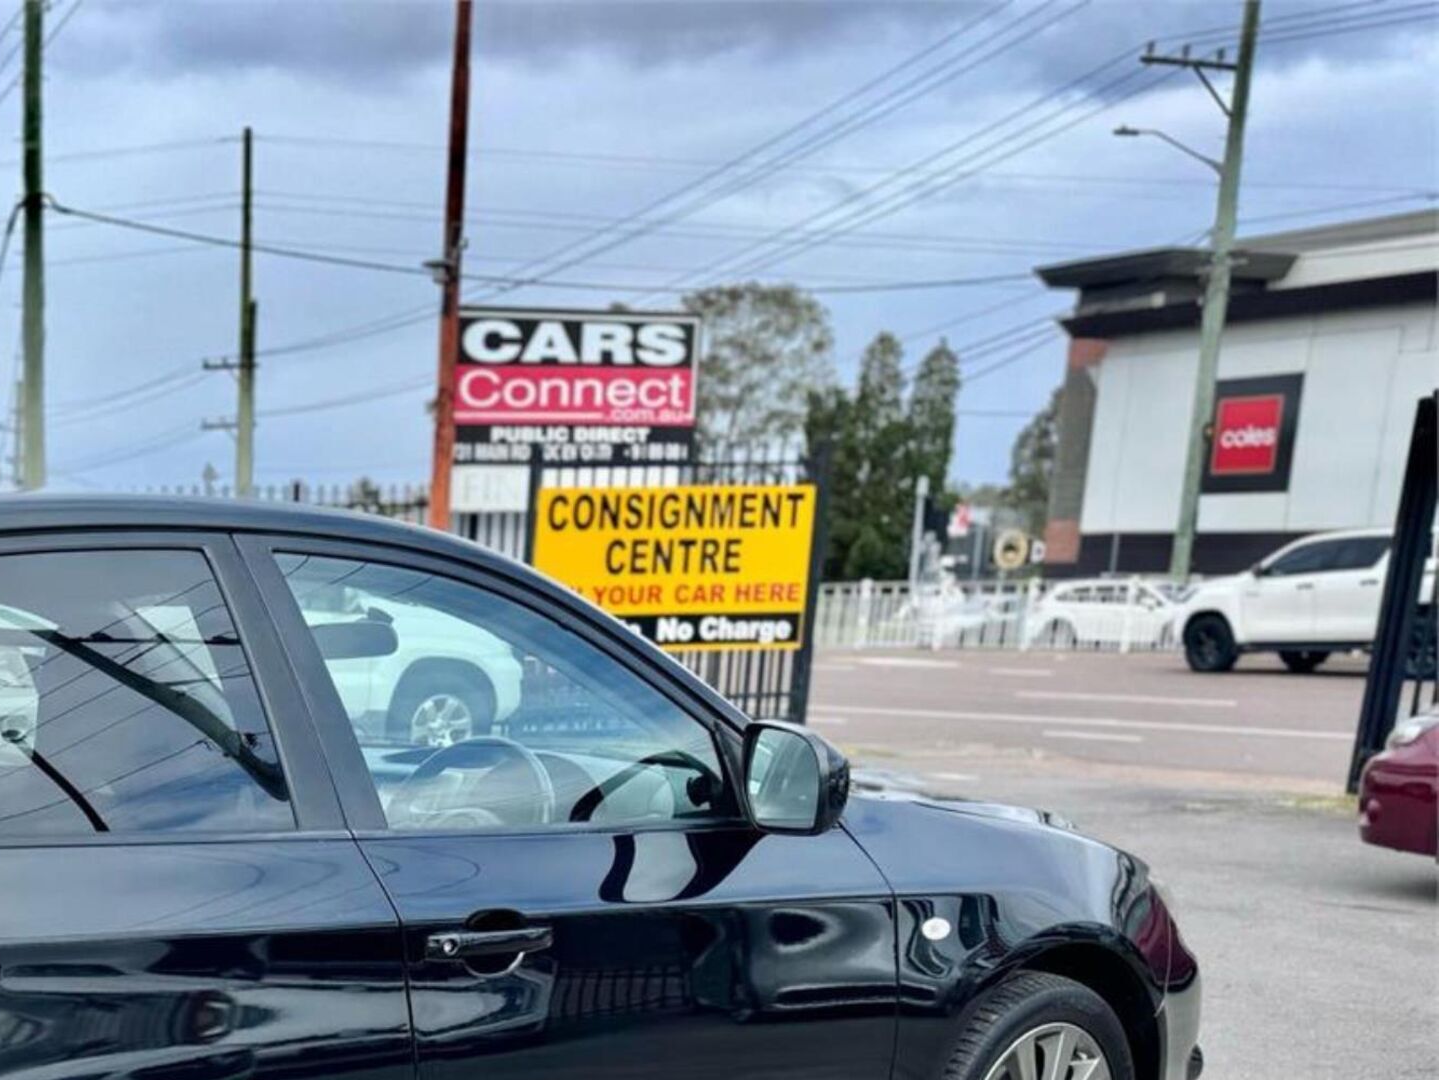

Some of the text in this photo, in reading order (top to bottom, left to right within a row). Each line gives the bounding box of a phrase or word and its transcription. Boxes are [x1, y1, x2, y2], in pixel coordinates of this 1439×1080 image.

[462, 319, 687, 366] CARS
[459, 369, 685, 409] Connect
[490, 426, 651, 443] PUBLIC DIRECT
[547, 492, 805, 531] CONSIGNMENT
[605, 539, 743, 575] CENTRE
[593, 586, 663, 606] YOUR
[674, 584, 725, 604] CAR
[735, 583, 801, 603] HERE
[656, 617, 694, 642] No
[699, 615, 792, 642] Charge
